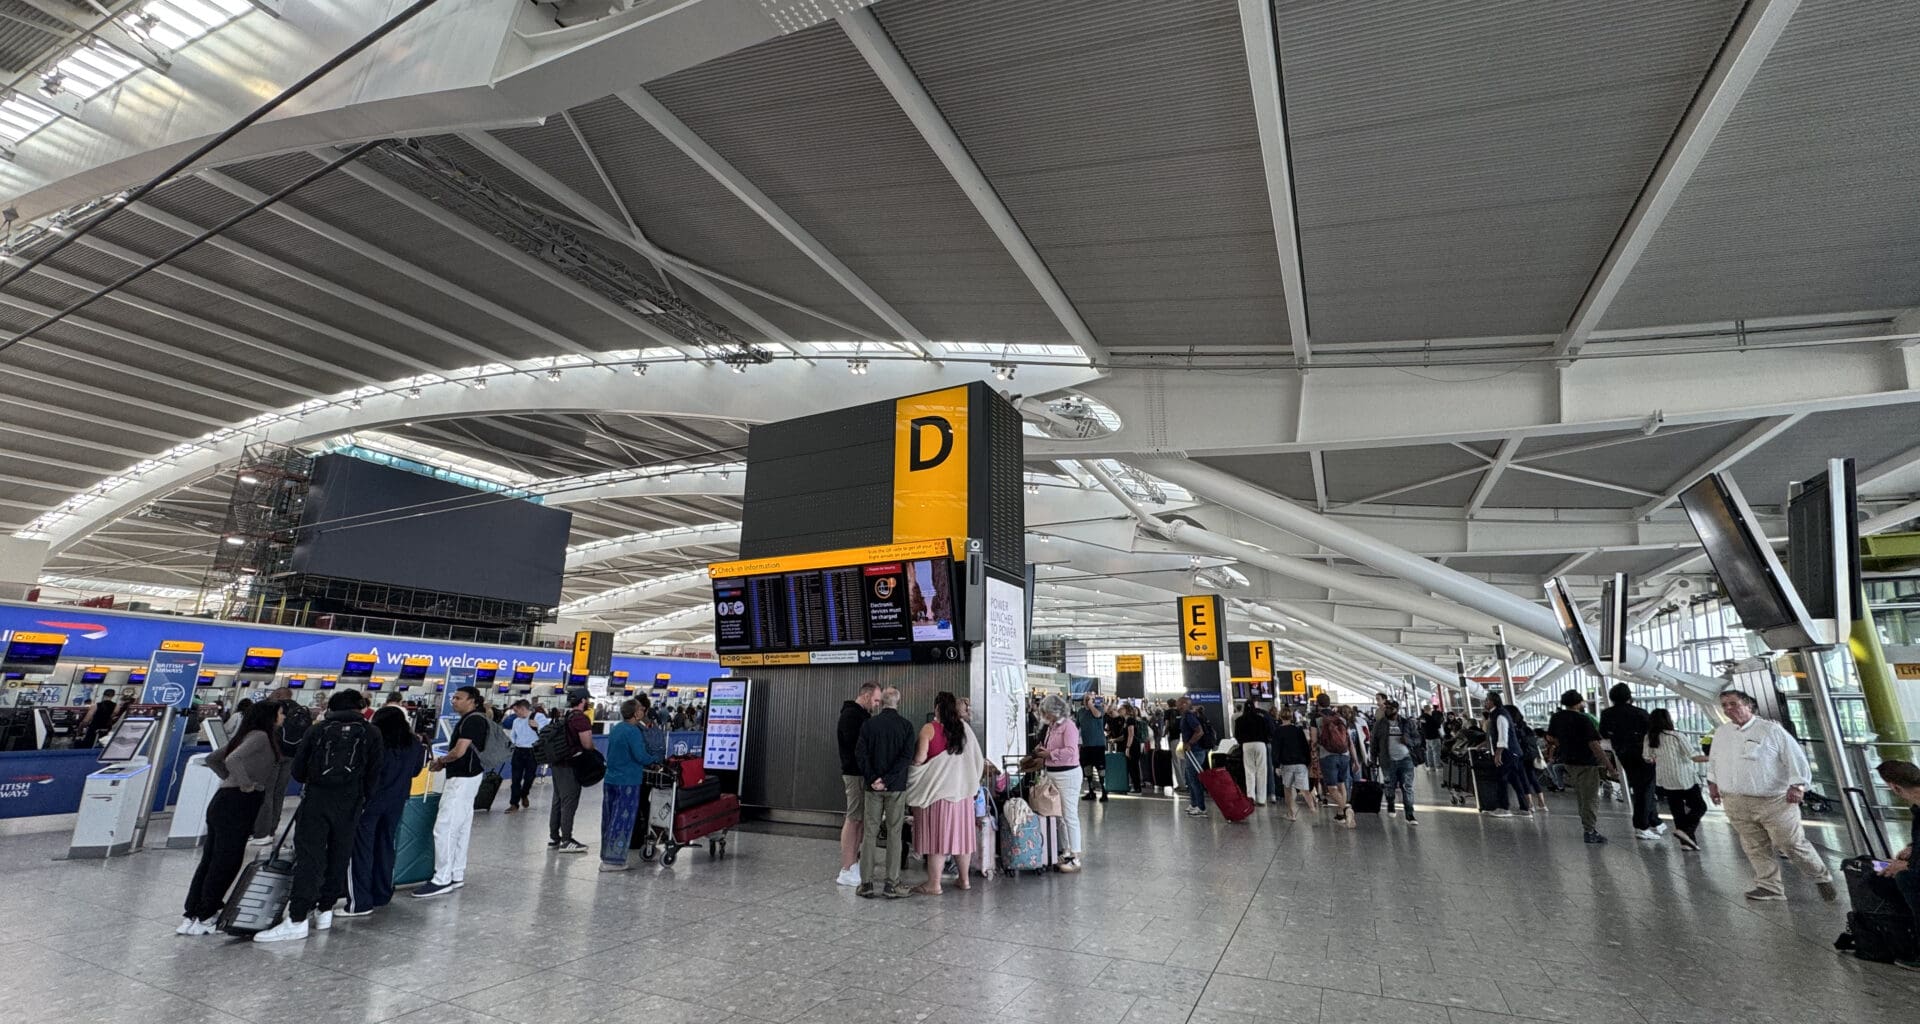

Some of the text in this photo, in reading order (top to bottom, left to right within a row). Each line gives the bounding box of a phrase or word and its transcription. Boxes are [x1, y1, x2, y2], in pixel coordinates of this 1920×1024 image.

[909, 415, 953, 472] D
[717, 564, 743, 573] Check-in
[991, 597, 1009, 612] POWER
[1191, 605, 1206, 626] E
[991, 623, 1016, 639] TO POWER
[580, 637, 587, 652] E
[369, 646, 380, 664] A
[387, 652, 433, 667] warm
[439, 653, 508, 671] welcome
[512, 658, 527, 671] to
[532, 661, 556, 673] our
[1254, 646, 1264, 660] F
[1294, 673, 1303, 682] G
